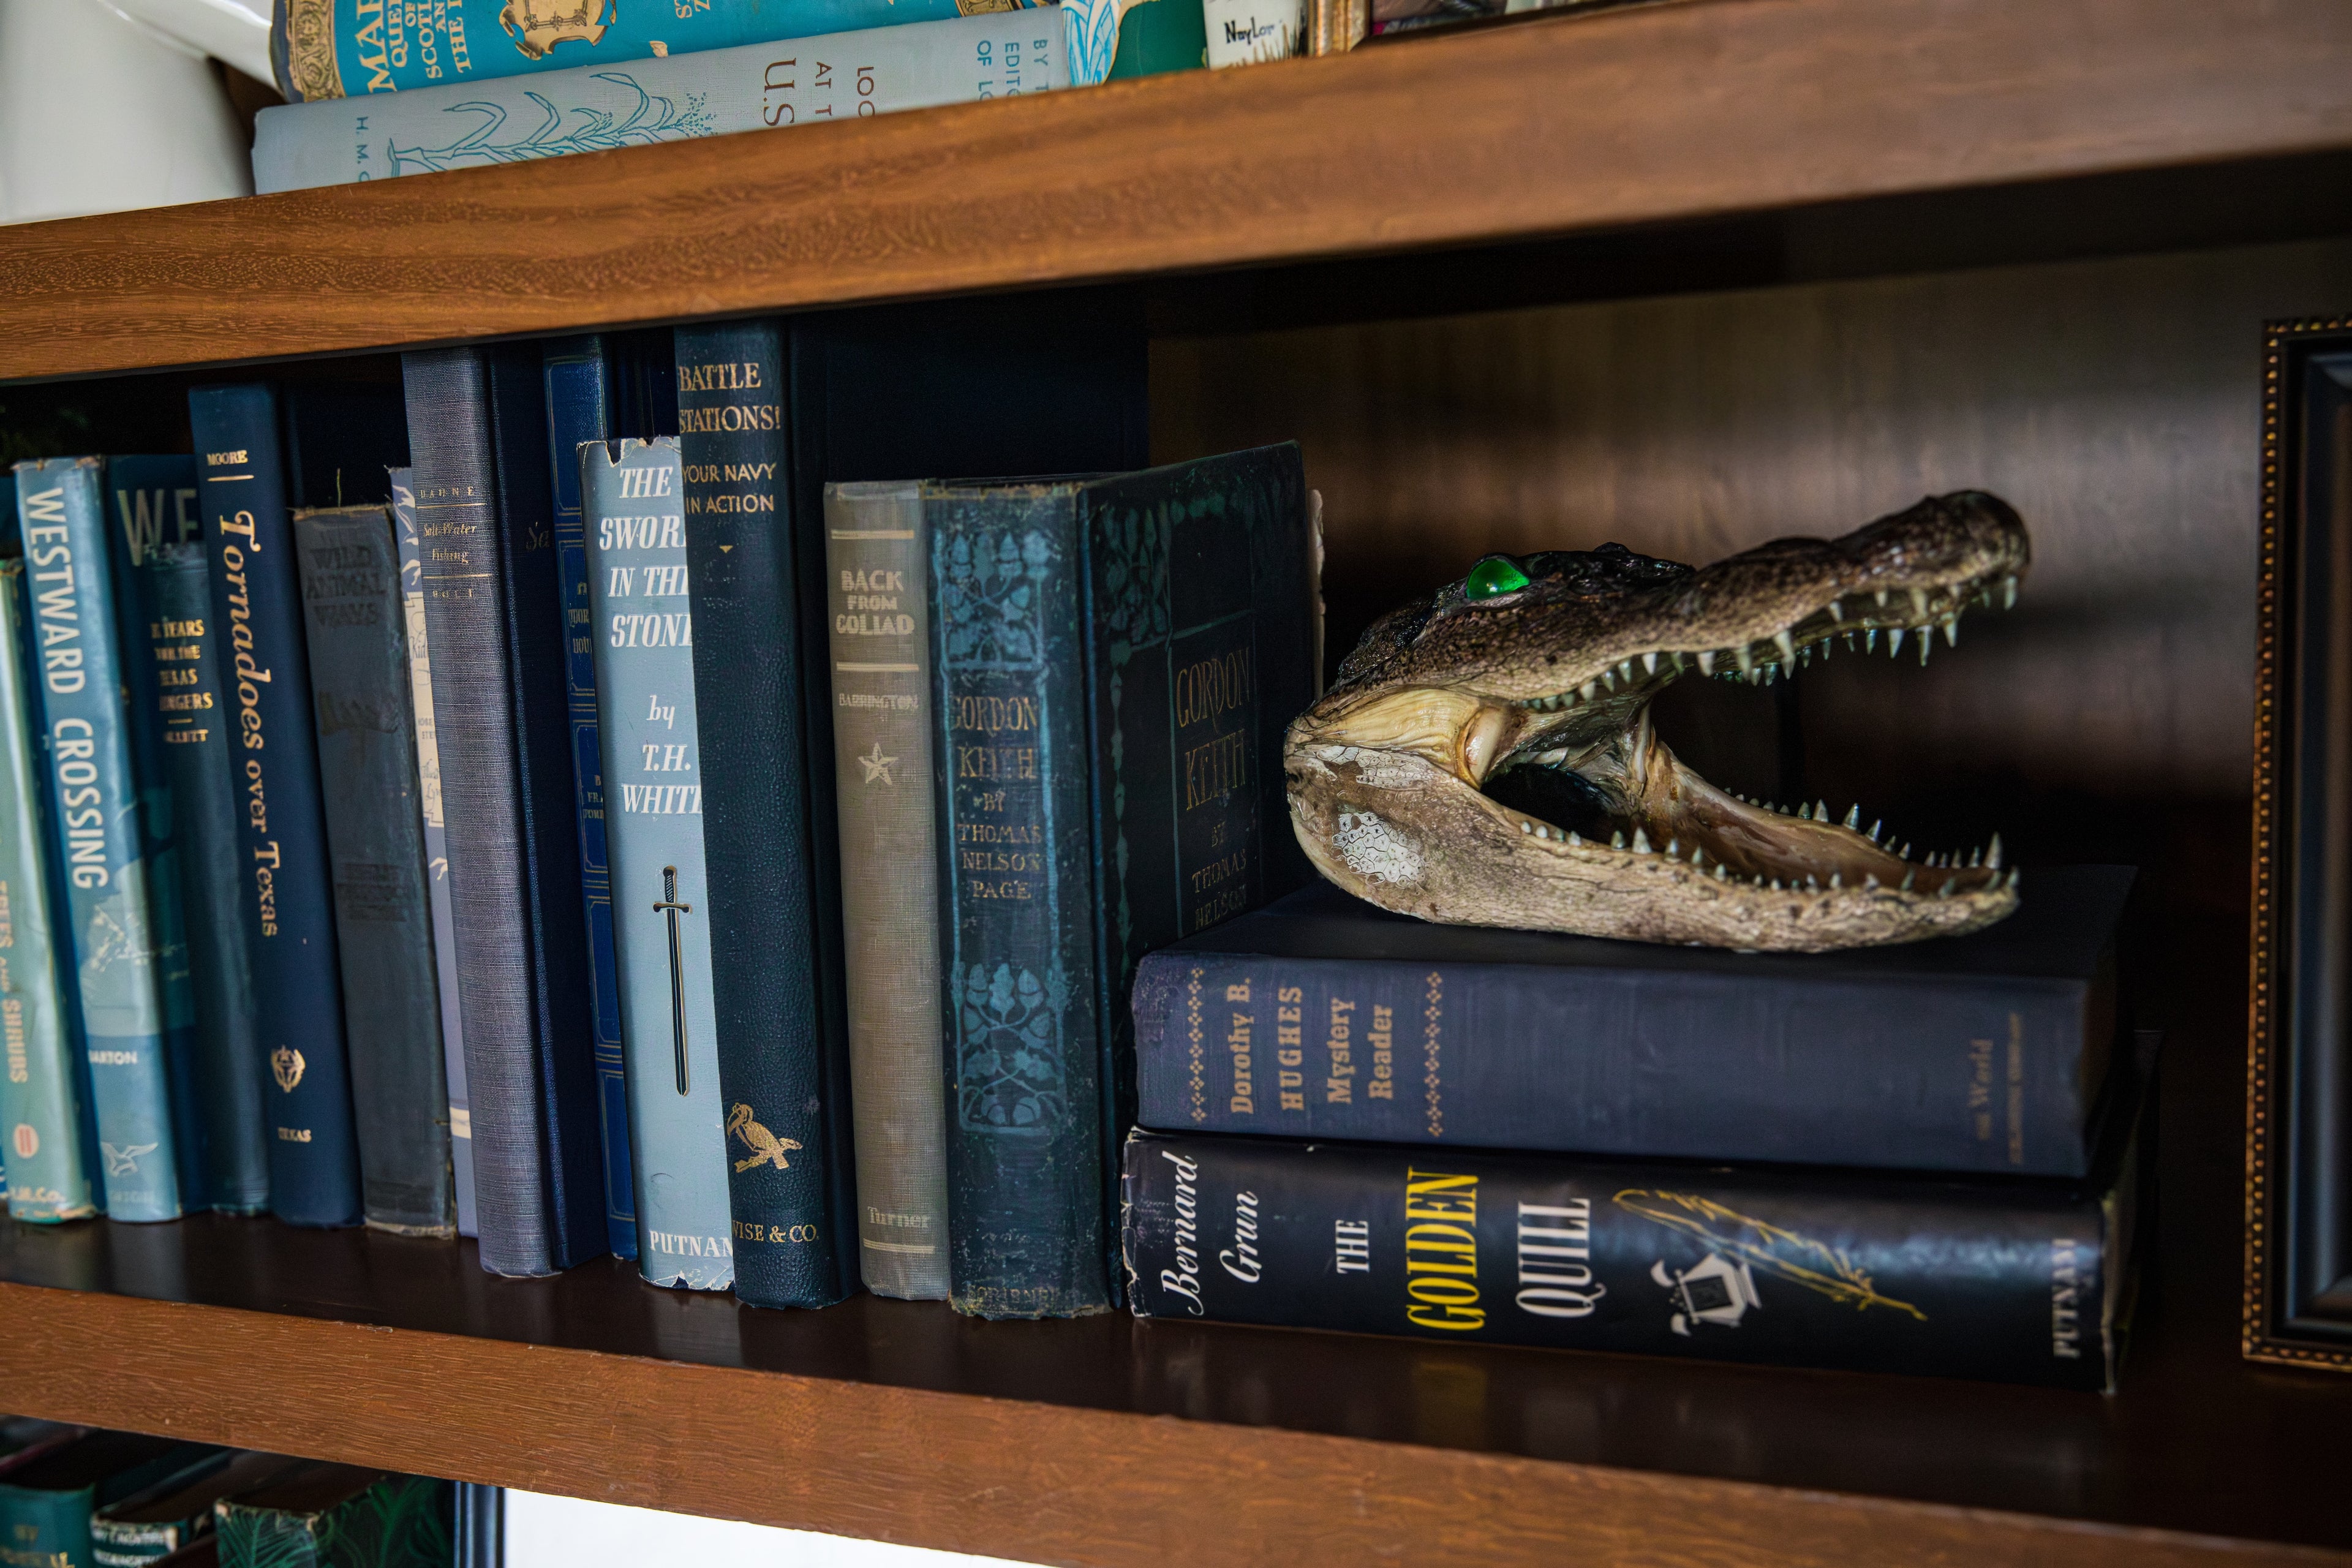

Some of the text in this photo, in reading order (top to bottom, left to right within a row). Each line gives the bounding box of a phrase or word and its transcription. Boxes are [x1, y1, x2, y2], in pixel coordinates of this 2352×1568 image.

[448, 17, 472, 74] THE
[1225, 21, 1276, 45] Naylor
[978, 40, 993, 66] OF
[1033, 39, 1049, 66] BY
[815, 61, 833, 89] AT
[356, 116, 369, 134] H.
[357, 144, 369, 164] M.
[678, 363, 762, 392] BATTLE
[680, 405, 782, 434] STATIONS!
[206, 450, 248, 466] MOORE
[682, 462, 777, 484] YOUR NAVY
[619, 467, 673, 499] THE
[685, 493, 775, 514] IN ACTION
[598, 514, 687, 551] SWOR
[608, 567, 636, 598] IN
[842, 569, 903, 592] BACK
[847, 595, 897, 611] FROM
[835, 613, 915, 636] GOLIAD
[25, 488, 109, 889] WESTWARD CROSSING
[1175, 646, 1251, 729] GORDON
[219, 510, 280, 937] Tornadoes over Texas
[646, 695, 676, 729] by
[951, 696, 1038, 733] GORDON
[641, 744, 692, 772] T.H.
[957, 745, 1038, 779] KEITH
[1185, 729, 1247, 811] KEITH
[956, 823, 1041, 845] THOMAS
[962, 852, 1041, 872] NELSON
[1191, 857, 1247, 894] THOMAS
[971, 880, 1031, 900] PAGE
[1227, 978, 1254, 1115] Dorothy B.
[1278, 986, 1305, 1112] HUGHES
[1326, 997, 1356, 1104] Mystery
[1367, 1004, 1393, 1100] Reader
[769, 1225, 786, 1243] &
[1160, 1150, 1205, 1317] Bernard
[1219, 1190, 1262, 1284] Grun
[1335, 1219, 1370, 1275] THE
[1406, 1165, 1486, 1332] GOLDEN
[1515, 1197, 1607, 1319] QUILL
